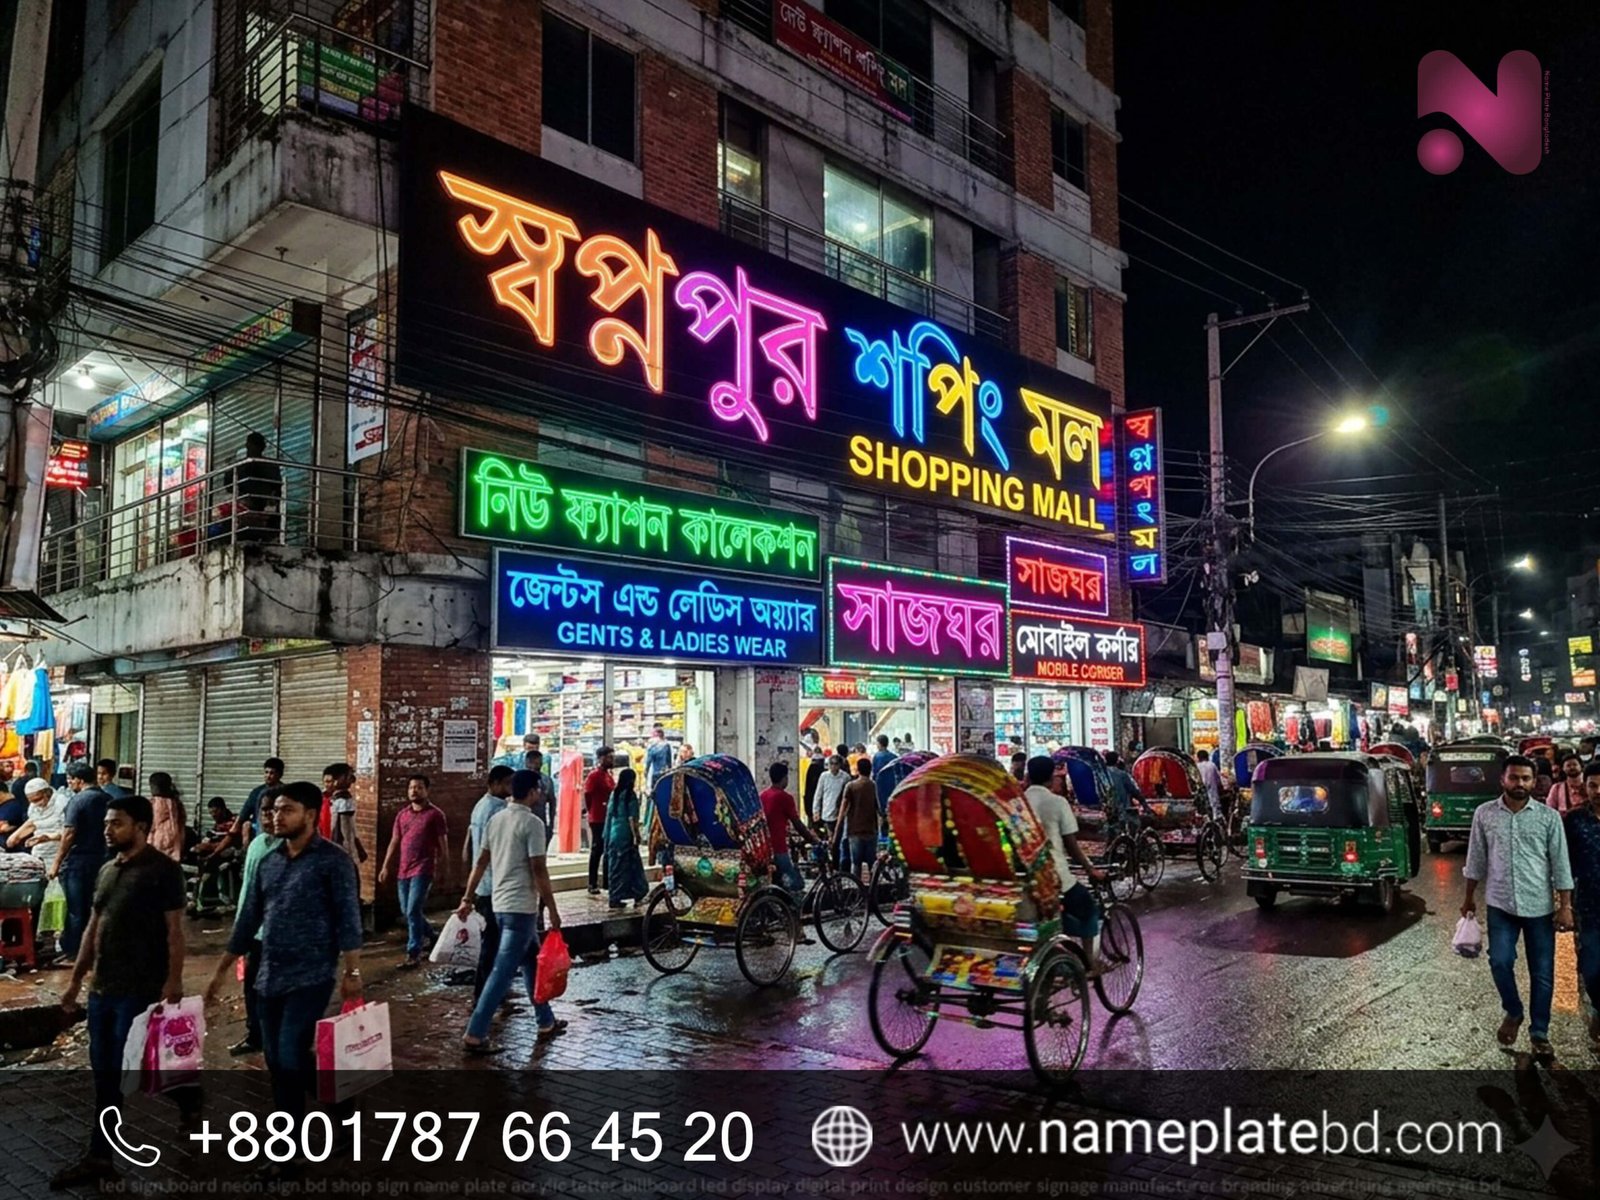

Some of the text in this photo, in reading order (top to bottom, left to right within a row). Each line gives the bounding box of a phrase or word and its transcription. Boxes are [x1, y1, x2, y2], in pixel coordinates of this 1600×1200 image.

[1020, 386, 1103, 490] মল
[474, 457, 816, 571] নিউ ফ্যাশন কালেকশন
[849, 435, 1105, 530] SHOPPING MALL
[506, 563, 604, 615] জেন্টস
[613, 583, 660, 617] এন্ড
[668, 580, 744, 627] লেডিস
[837, 580, 1004, 661] সাজঘর
[557, 621, 787, 658] GENTS & LADIES WEAR
[1016, 620, 1091, 660] মোবাইল
